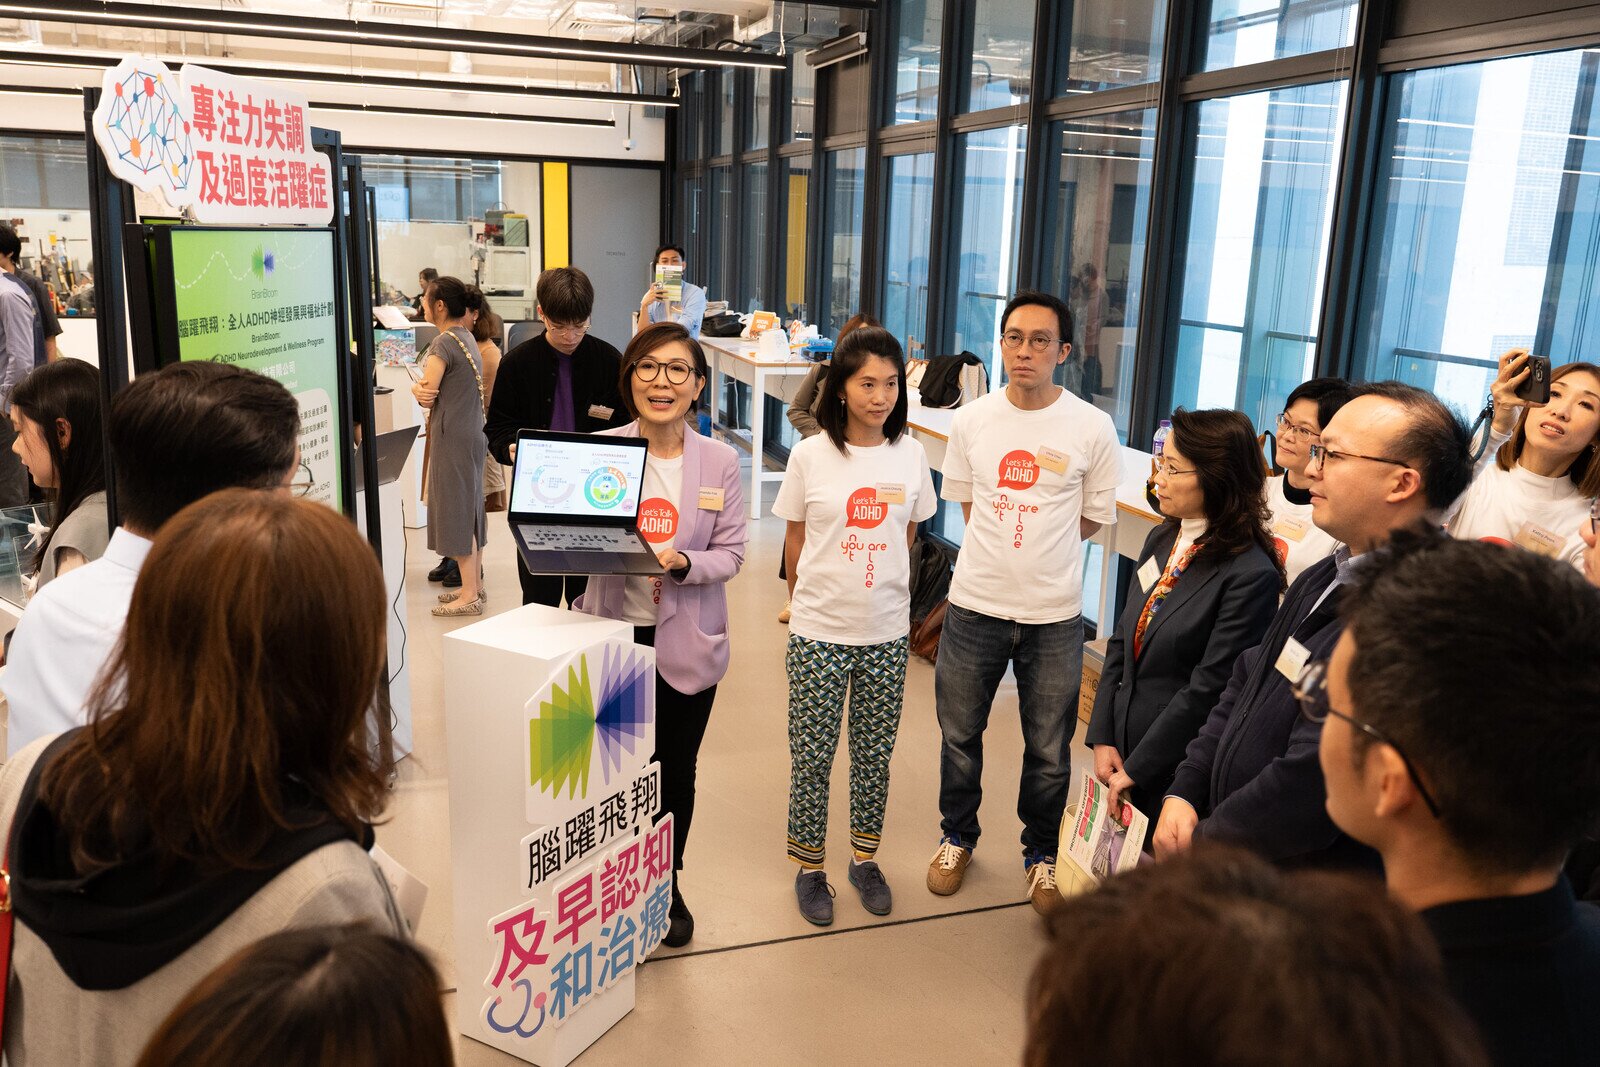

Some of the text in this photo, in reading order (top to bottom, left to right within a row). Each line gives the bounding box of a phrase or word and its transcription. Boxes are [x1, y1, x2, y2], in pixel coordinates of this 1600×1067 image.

[190, 83, 304, 154] 專注力失調
[197, 150, 328, 210] 及過度活躍症
[220, 353, 236, 364] ADHD
[237, 346, 283, 360] Neurodevelopment
[282, 343, 288, 352] &
[287, 341, 306, 350] Wellness
[307, 337, 325, 348] Program
[1005, 458, 1022, 467] Let's
[1003, 466, 1034, 483] ADHD
[852, 496, 869, 505] Let's
[992, 501, 1039, 513] you are
[641, 507, 673, 518] Let's Talk
[852, 505, 882, 520] ADHD
[640, 516, 673, 534] ADHD
[840, 541, 887, 554] you are
[527, 770, 659, 889] 腦躍飛翔
[492, 818, 673, 989] 及早認知
[548, 878, 672, 1021] 和治療
